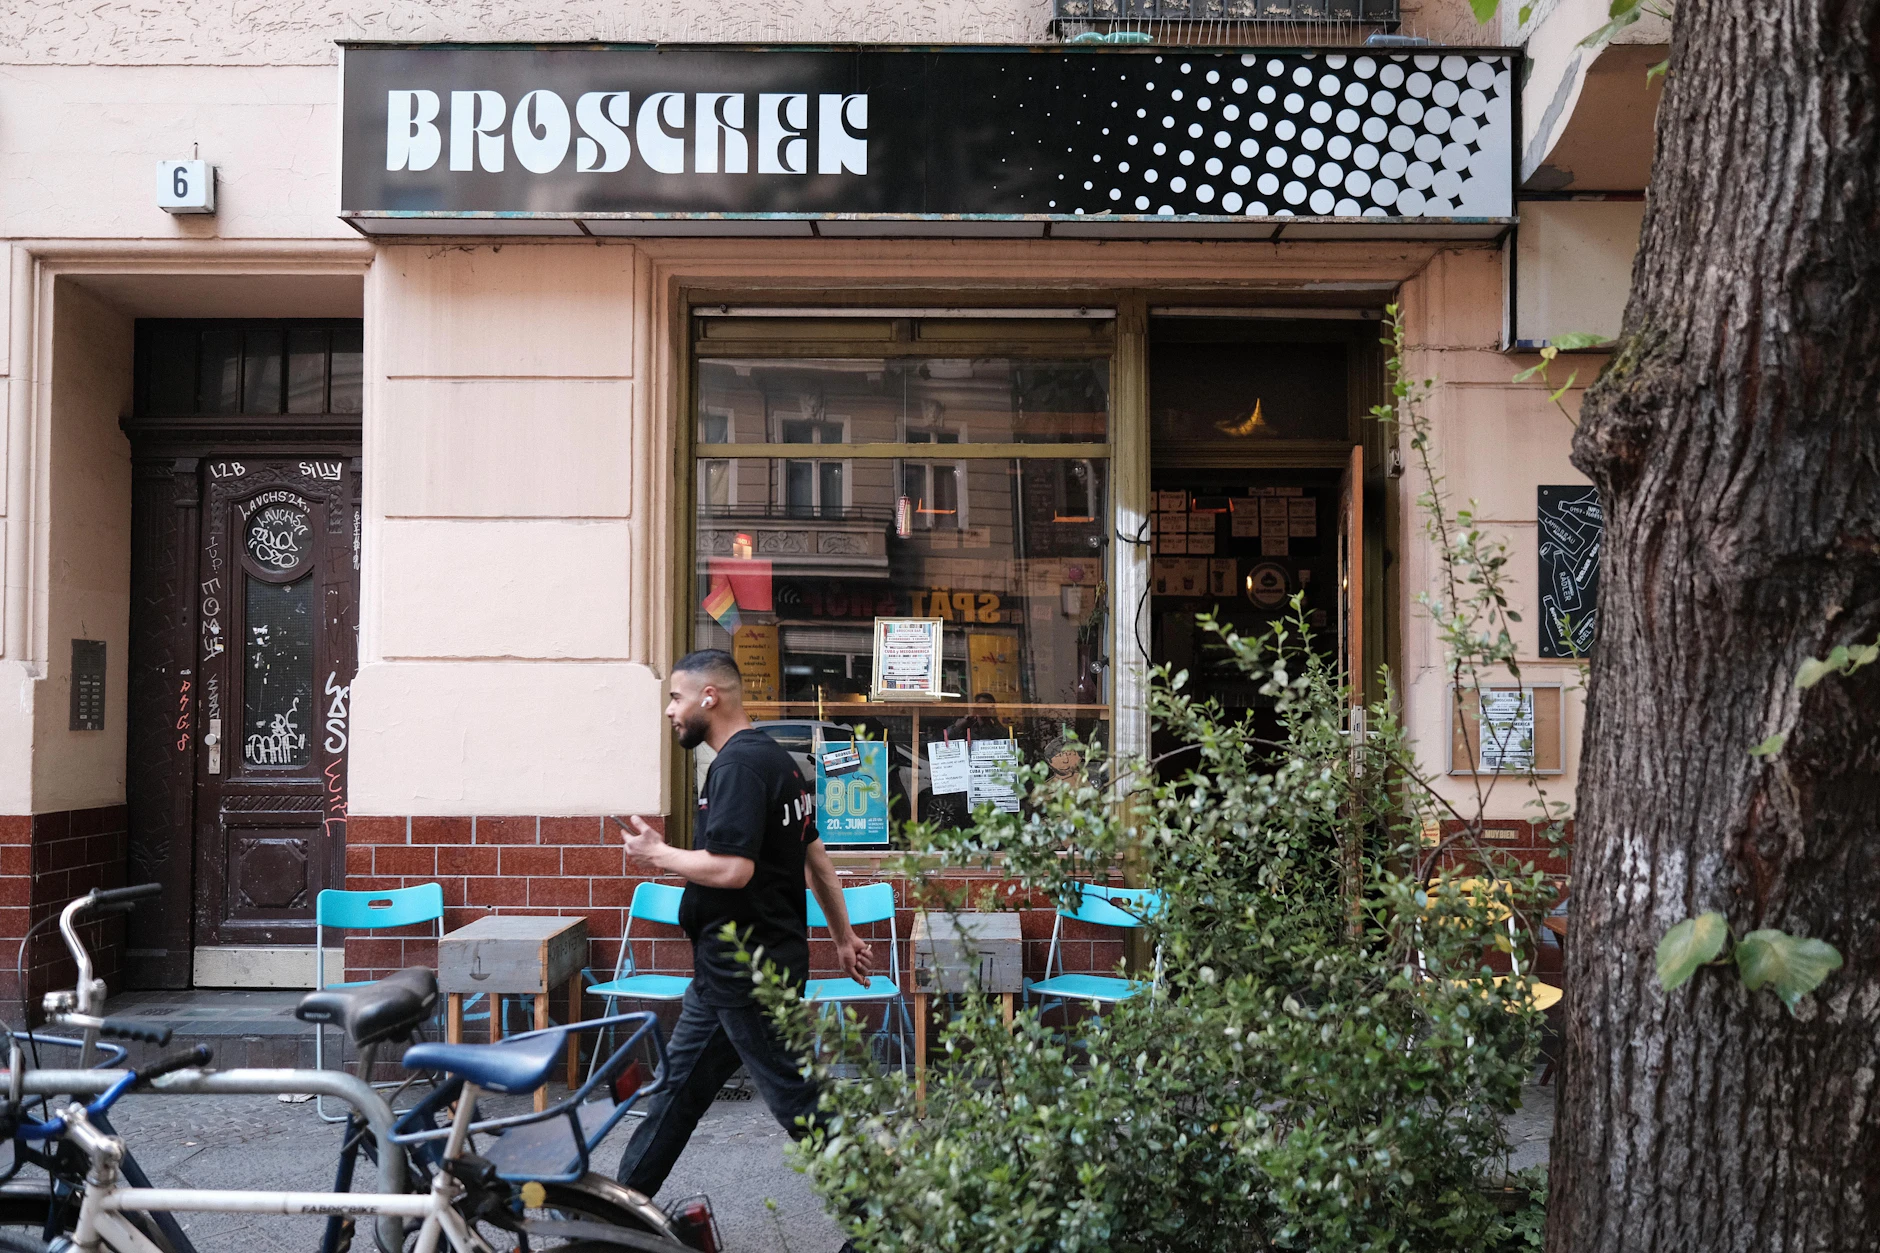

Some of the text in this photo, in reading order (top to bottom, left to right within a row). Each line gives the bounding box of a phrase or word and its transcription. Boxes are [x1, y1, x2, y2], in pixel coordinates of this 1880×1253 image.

[386, 89, 868, 175] BROSCHEK
[173, 166, 188, 198] 6
[827, 818, 842, 830] 20.
[845, 818, 867, 830] JUNI
